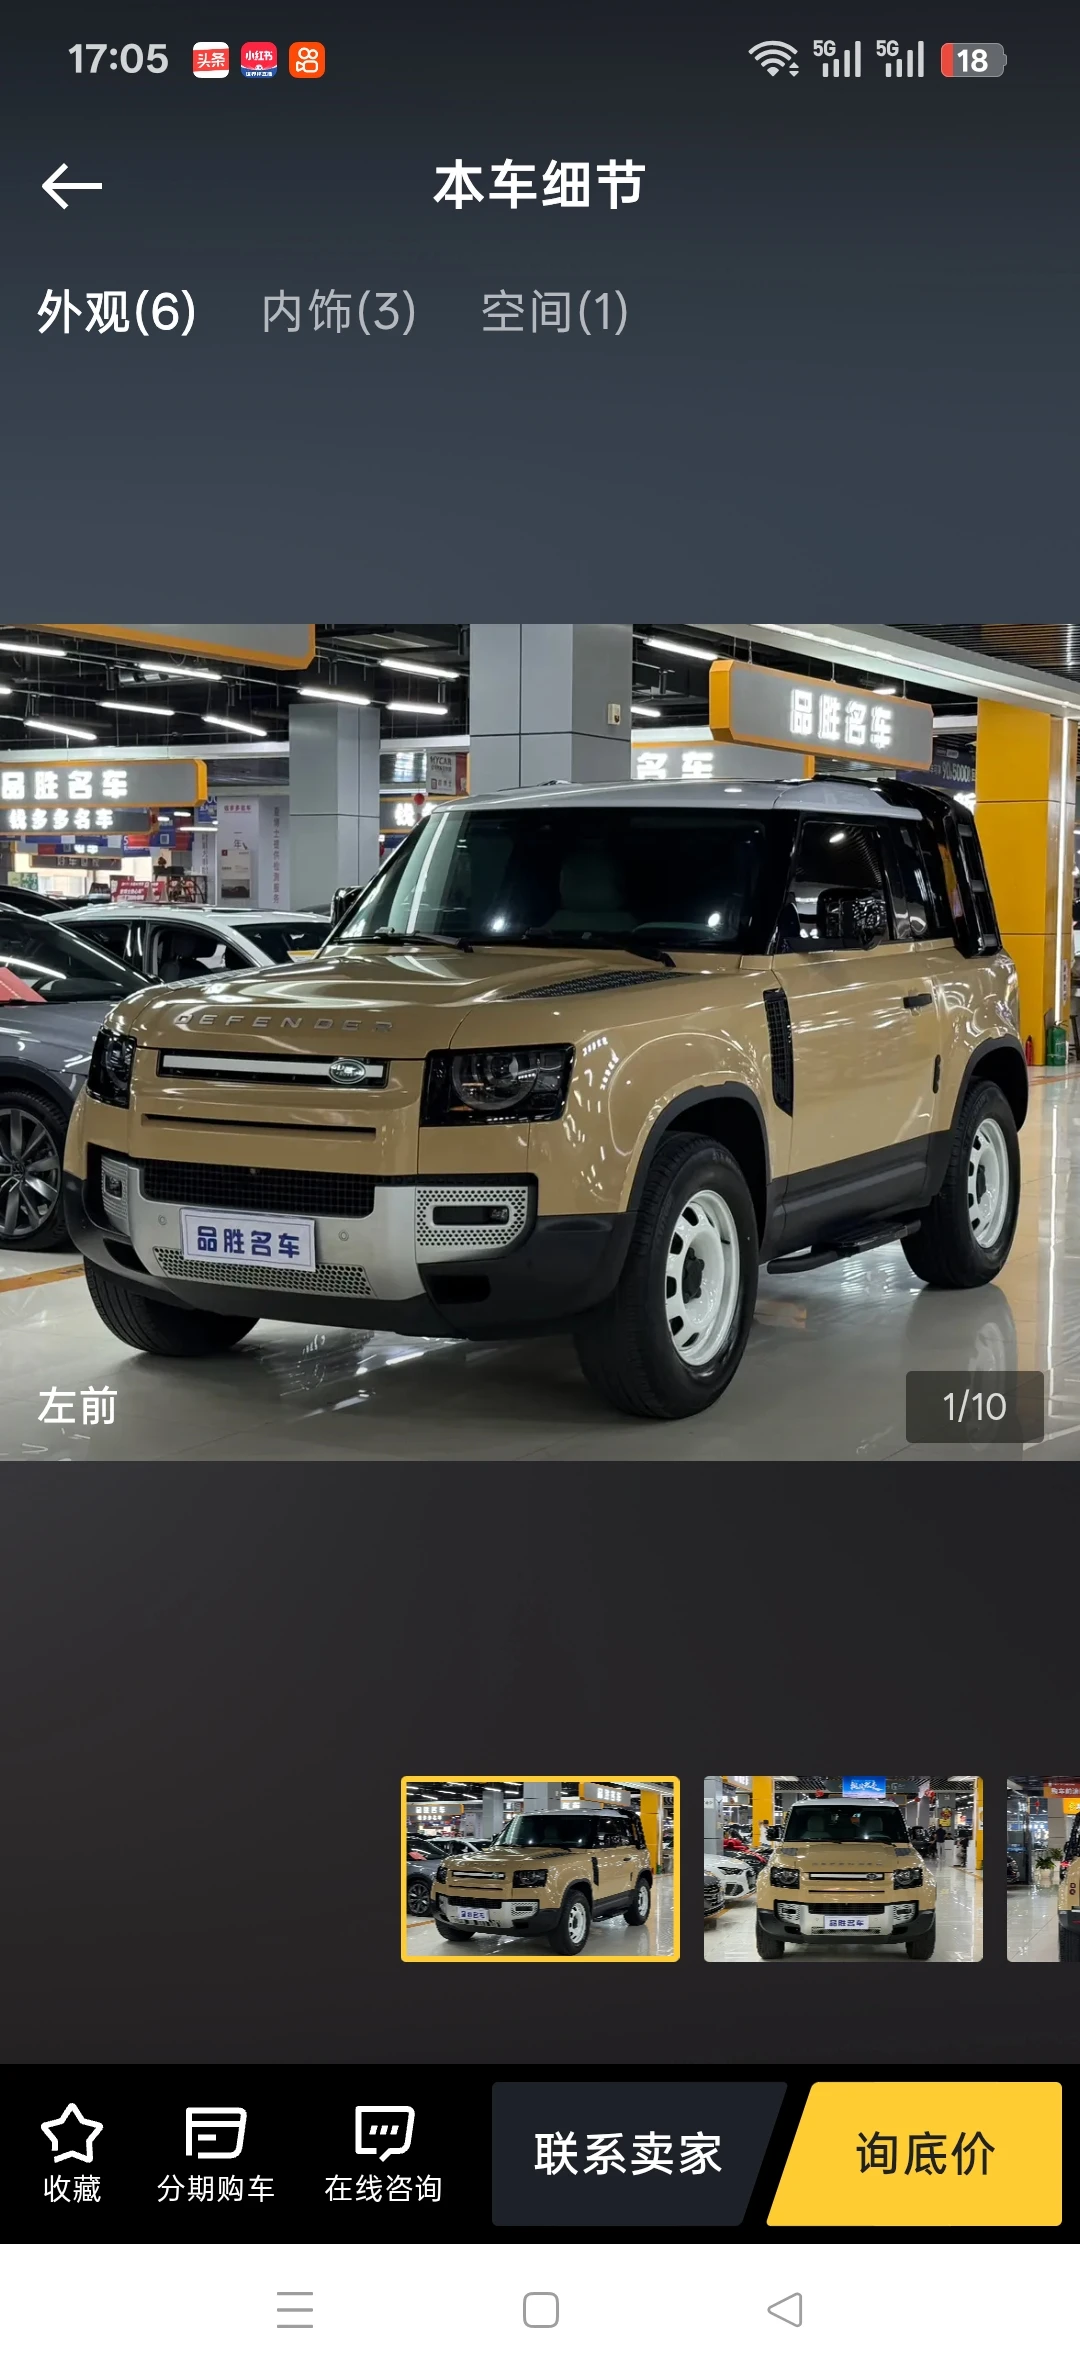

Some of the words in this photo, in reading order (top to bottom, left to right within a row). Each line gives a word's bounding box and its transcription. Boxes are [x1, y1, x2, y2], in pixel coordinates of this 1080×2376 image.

[68, 43, 169, 74] 17:05
[197, 52, 225, 69] 头条
[245, 50, 273, 61] 小红书
[813, 39, 836, 57] 5G
[876, 39, 899, 57] 5G
[957, 48, 989, 73] 18
[432, 158, 646, 210] 本车细节
[36, 288, 195, 337] 外观(6)
[263, 288, 416, 336] 内饰(3)
[482, 288, 628, 336] 空间(1)
[790, 688, 893, 749] 品胜名车
[636, 751, 714, 779] 名车
[1, 770, 128, 799] 品胜名车
[9, 808, 114, 830] 钱多多名车
[173, 1013, 394, 1033] DEFENDER
[196, 1225, 301, 1259] 品胜名车
[534, 2130, 723, 2176] 联系卖家
[856, 2130, 996, 2176] 询底价
[43, 2174, 102, 2204] 收藏
[157, 2173, 275, 2203] 分期购车
[324, 2173, 442, 2203] 在线咨询
